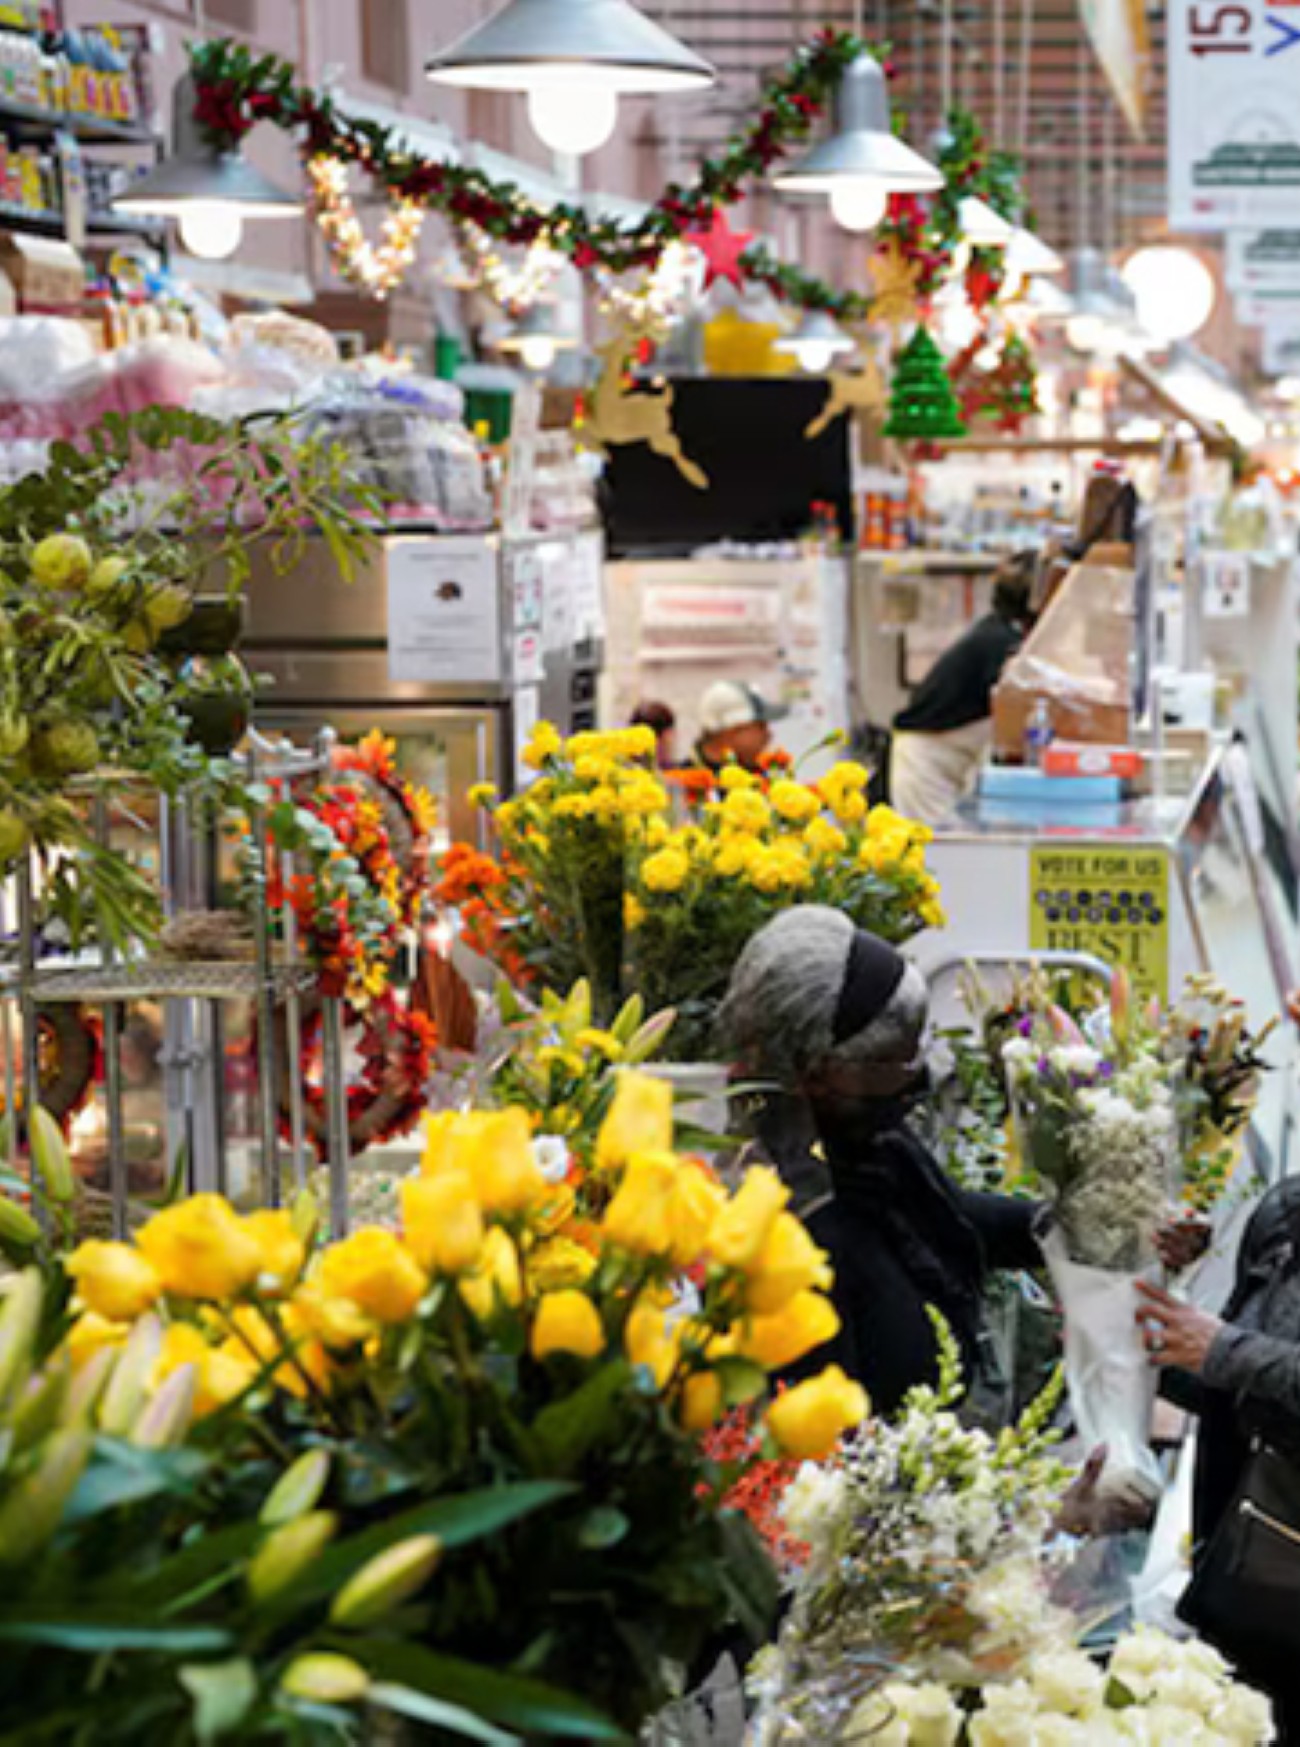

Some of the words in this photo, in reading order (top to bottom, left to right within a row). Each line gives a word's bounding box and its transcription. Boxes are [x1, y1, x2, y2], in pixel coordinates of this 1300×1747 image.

[1038, 856, 1086, 875] VOTE
[1092, 856, 1129, 876] FOR
[1134, 856, 1162, 876] US
